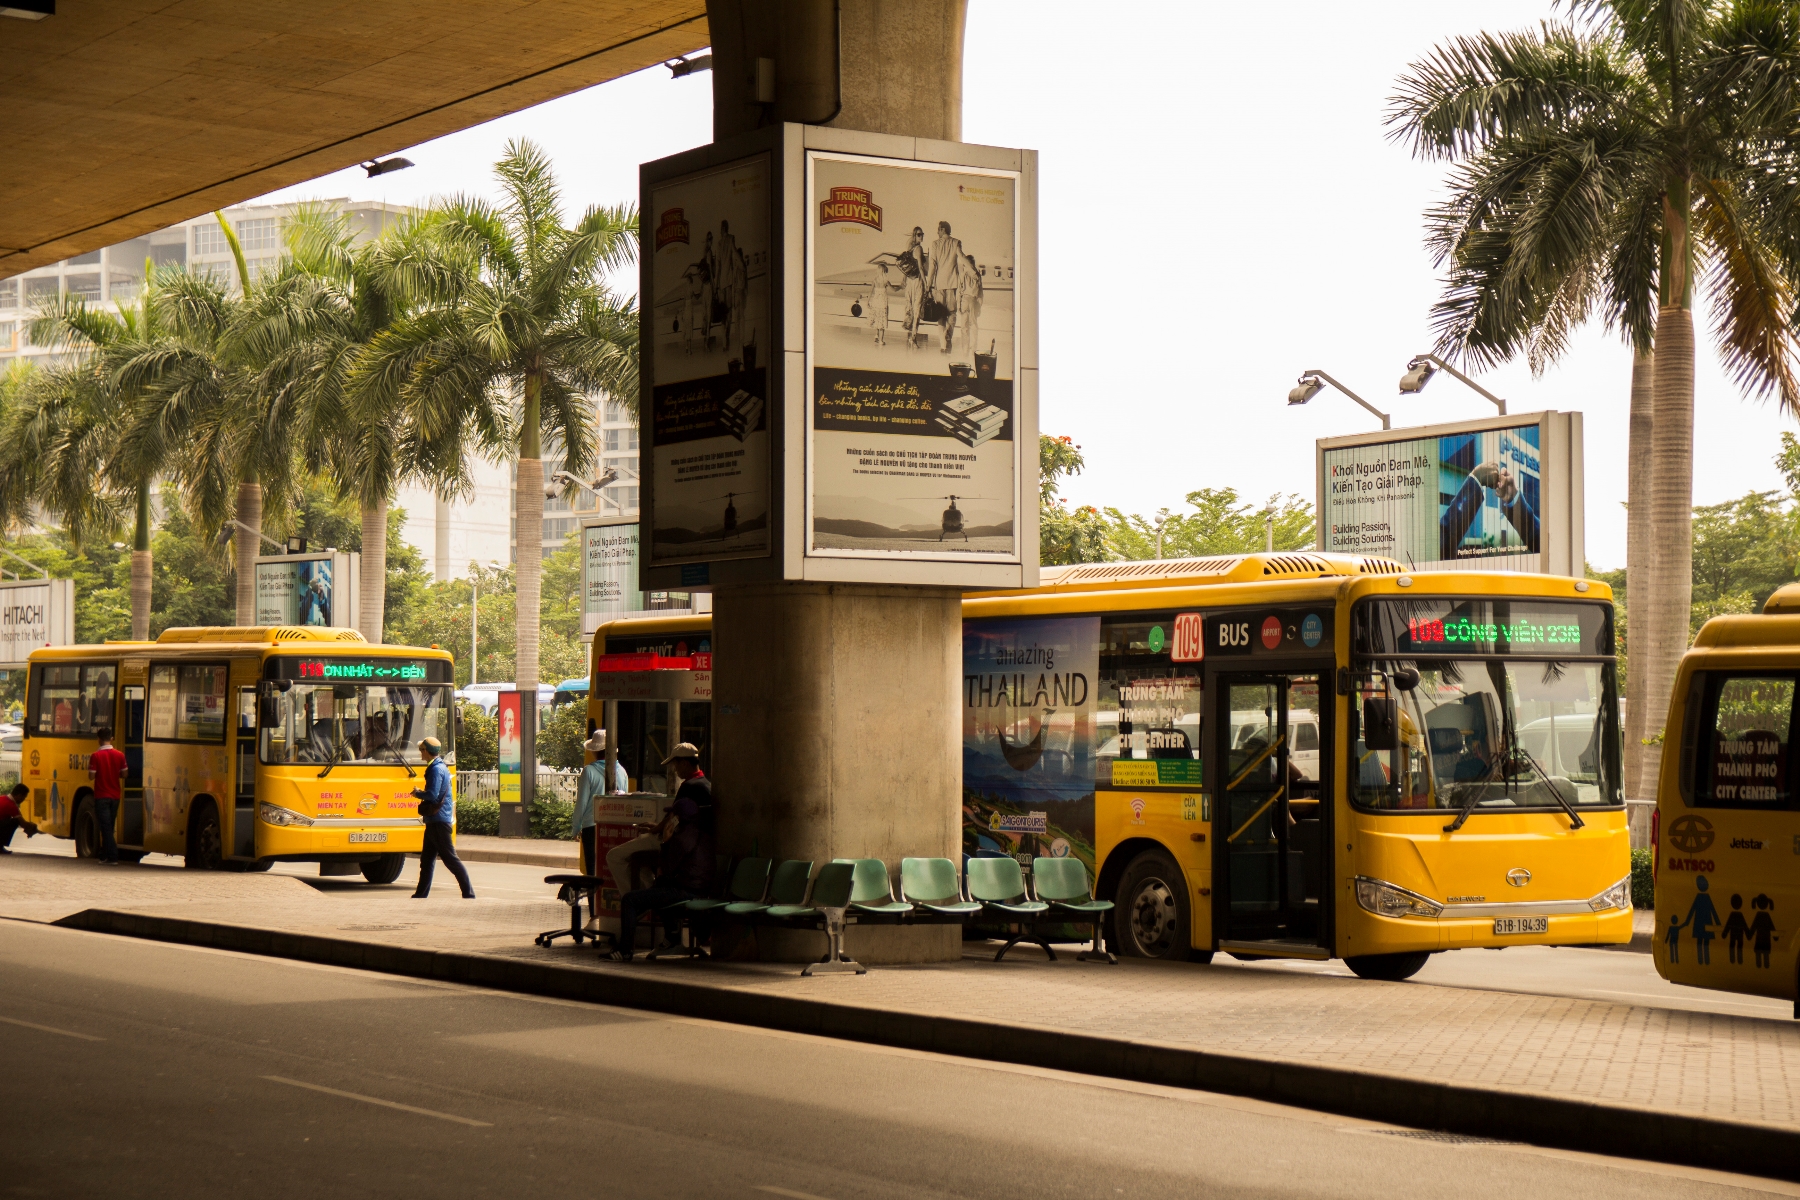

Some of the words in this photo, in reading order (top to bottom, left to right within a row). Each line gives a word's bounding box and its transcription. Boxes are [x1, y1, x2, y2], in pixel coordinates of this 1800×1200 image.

[836, 192, 866, 203] TRUNG
[824, 204, 878, 223] NGUYÊN
[1356, 459, 1386, 477] Nguồn
[1390, 459, 1410, 471] Đam
[1414, 455, 1431, 469] Mê,
[1332, 479, 1353, 493] Kiến
[1356, 480, 1373, 493] Tạo
[1376, 475, 1394, 489] Giải
[1397, 473, 1424, 488] Pháp.
[1387, 492, 1415, 501] Panasonic
[1332, 524, 1360, 534] Building
[1361, 521, 1390, 533] Passion,
[1333, 536, 1360, 546] Building
[1361, 533, 1395, 544] Solutions.
[4, 605, 43, 625] HITACHI
[1263, 628, 1280, 637] AIRPORT
[1307, 620, 1316, 629] CITY
[1444, 618, 1497, 642] CÔNG
[1501, 619, 1544, 642] VIÊN
[1, 630, 20, 645] Inspire
[22, 629, 30, 641] the
[32, 628, 45, 641] Next
[1177, 616, 1200, 658] 109
[1219, 623, 1249, 647] BUS
[1303, 632, 1321, 640] CENTER
[696, 656, 707, 668] XE
[996, 643, 1054, 670] amazing
[300, 662, 324, 676] 119
[343, 663, 374, 677] NHẤT
[401, 664, 426, 678] BẾN
[215, 671, 225, 694] 119
[964, 673, 1088, 708] THAILAND
[1120, 686, 1156, 701] TRUNG
[1119, 705, 1157, 722] THÀNH
[1160, 704, 1184, 722] PHỐ
[1719, 713, 1783, 730] AIRPORT
[1118, 733, 1140, 748] CITY
[1145, 733, 1185, 748] CENTER
[1719, 741, 1754, 754] TRUNG
[1757, 738, 1779, 754] TÂM
[1717, 760, 1752, 777] THÀNH
[1755, 760, 1778, 777] PHỐ
[1716, 784, 1738, 799] CITY
[1739, 785, 1777, 800] CENTER
[1184, 795, 1196, 807] CỬA
[1001, 815, 1046, 827] SAIGONTOURIST
[1184, 809, 1196, 820] LÊN
[1730, 837, 1763, 850] Jetstar
[1669, 858, 1715, 872] SATSCO
